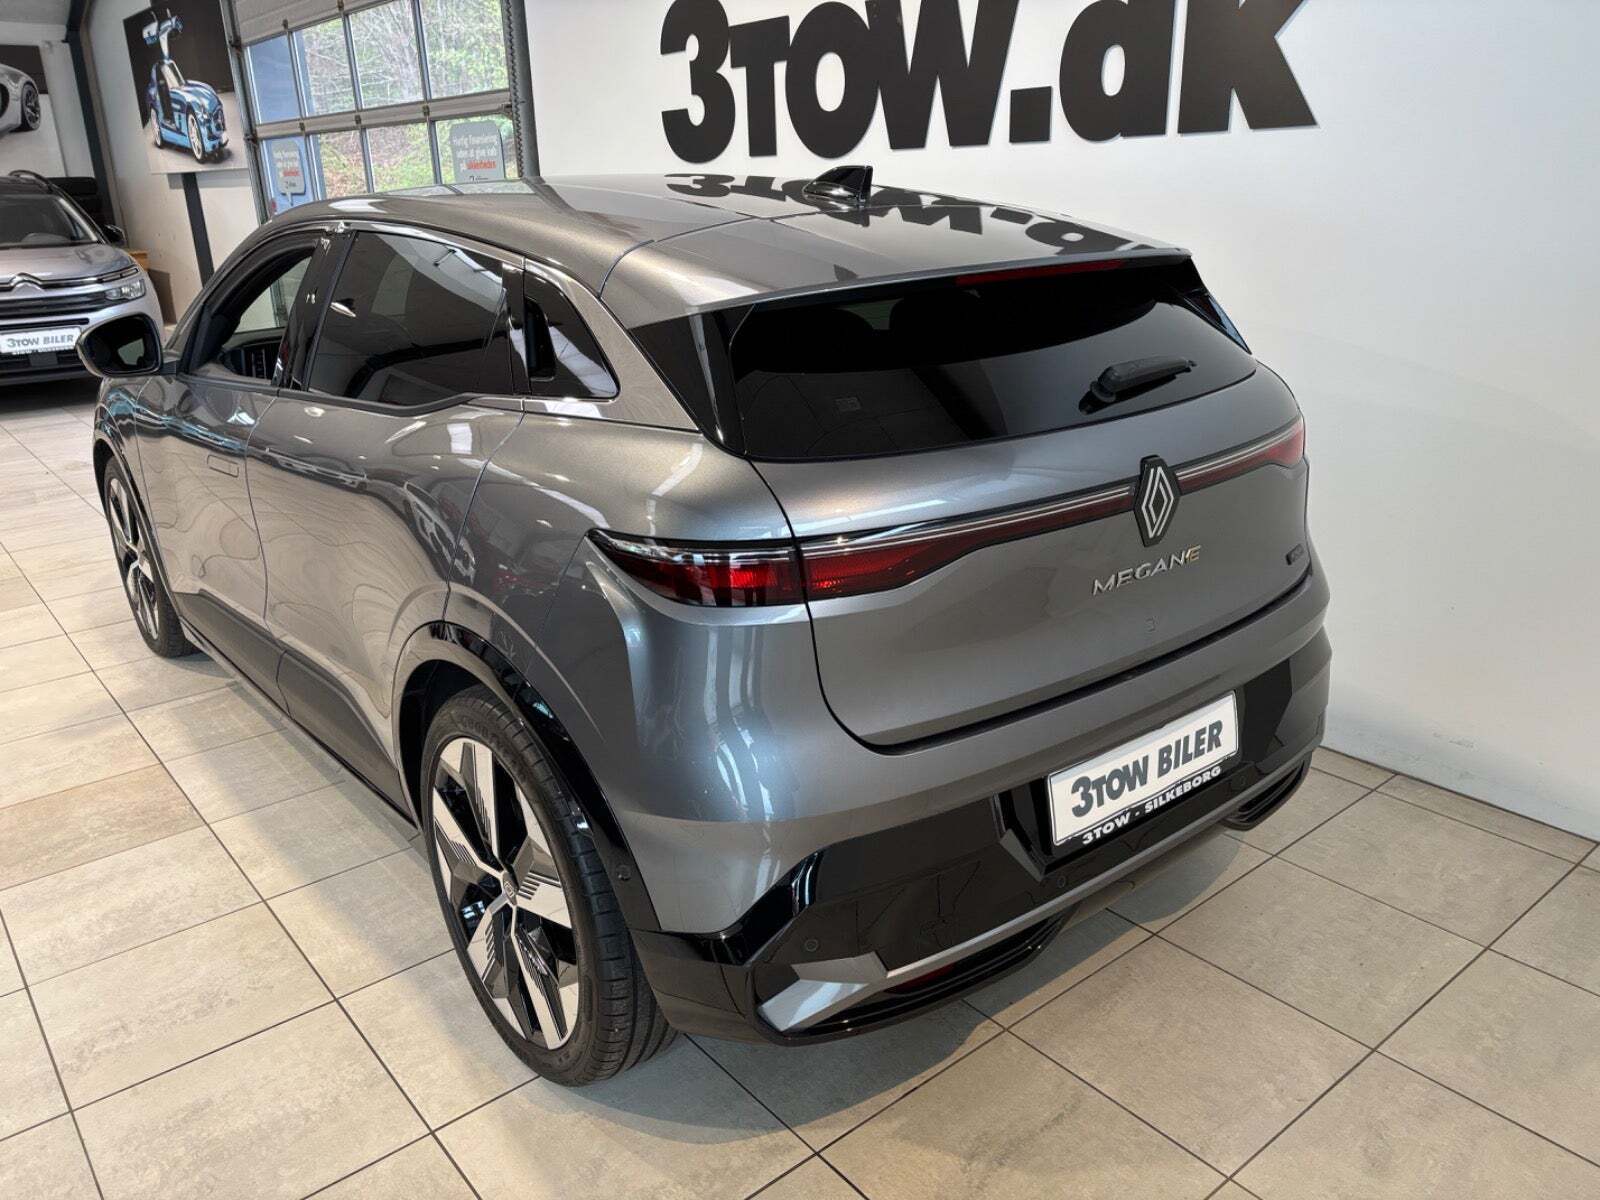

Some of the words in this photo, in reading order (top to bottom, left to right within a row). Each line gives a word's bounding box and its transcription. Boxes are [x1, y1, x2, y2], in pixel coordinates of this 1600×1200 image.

[7, 337, 40, 348] 3TOW
[43, 334, 74, 344] BILER
[1071, 755, 1149, 818] 3TOW
[1157, 720, 1223, 778] BILER
[1082, 812, 1131, 845] 3TOW
[1144, 765, 1222, 814] SILKEBORG
